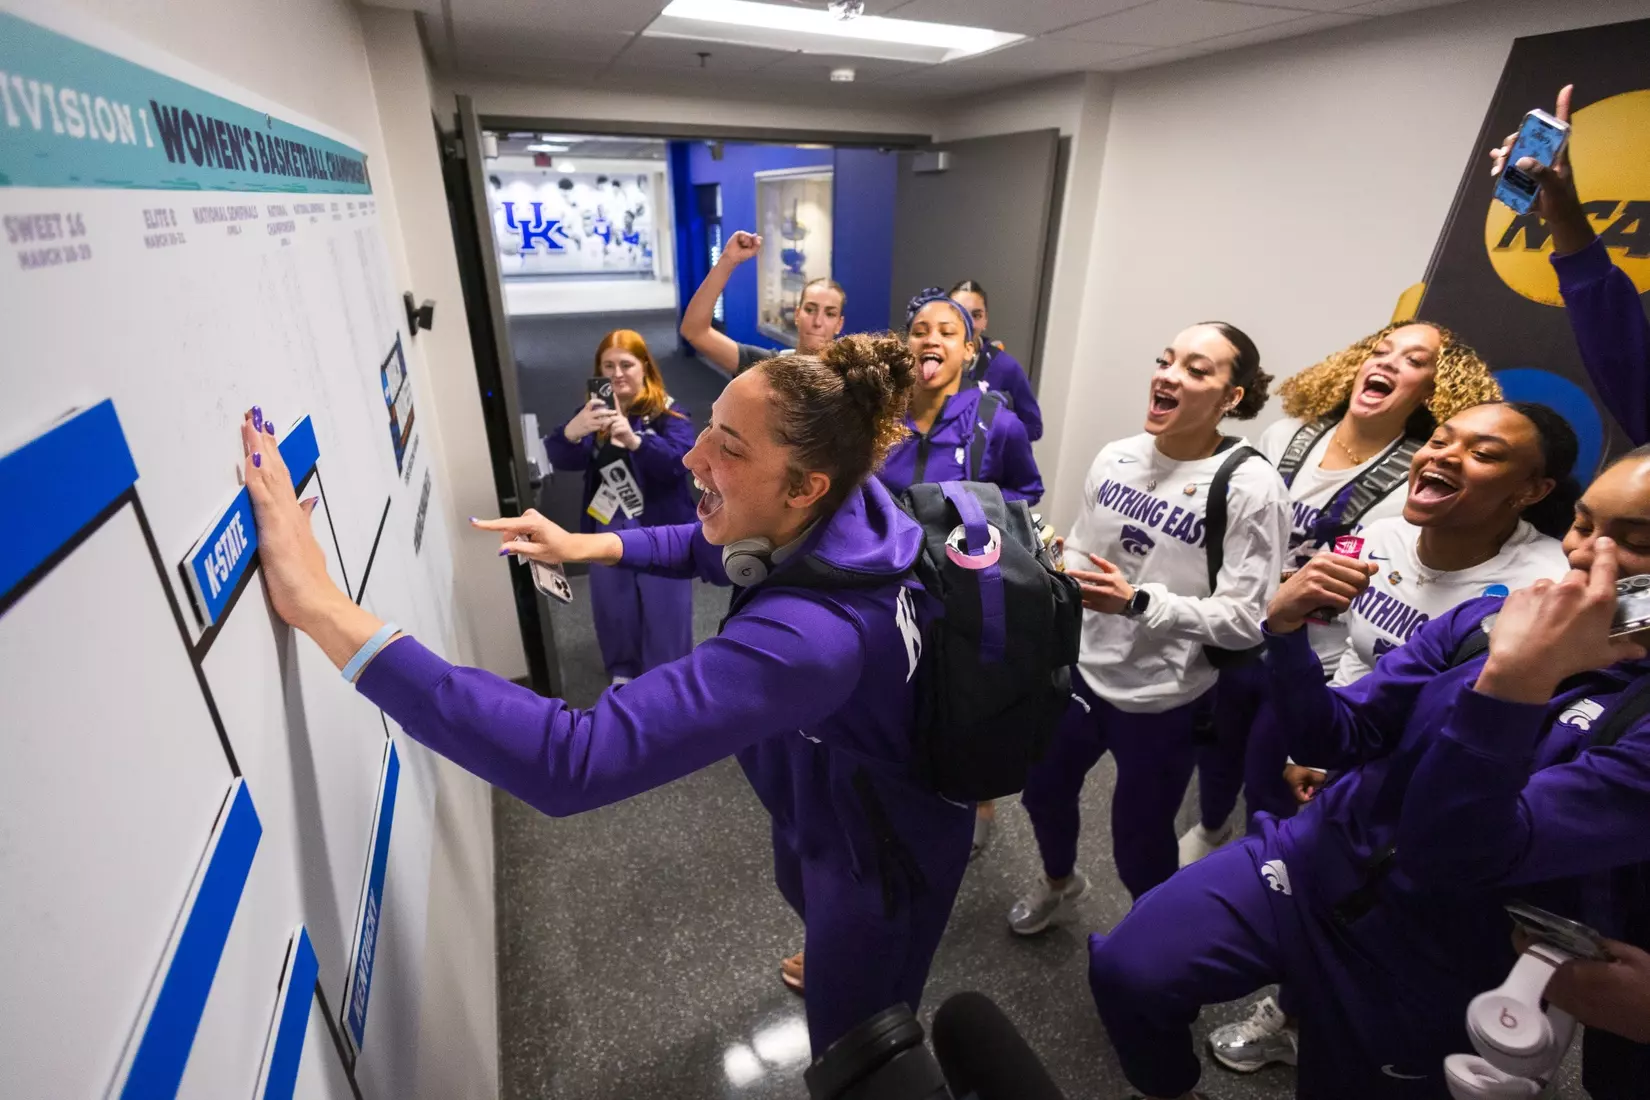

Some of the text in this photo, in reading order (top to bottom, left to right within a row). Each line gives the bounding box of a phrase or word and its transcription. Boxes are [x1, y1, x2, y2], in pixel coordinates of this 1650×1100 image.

[149, 97, 258, 172] WOMEN'S
[255, 130, 328, 180] BASKETBALL
[3, 212, 86, 244] SWEET 16
[142, 208, 171, 229] ELITE
[192, 206, 227, 225] NATIONAL
[501, 201, 565, 251] UK
[143, 233, 168, 249] MARCH
[18, 247, 63, 271] MARCH
[616, 481, 642, 511] TEAM
[1096, 479, 1207, 549] NOTHING EAS
[204, 510, 248, 599] K-STATE
[353, 887, 377, 1029] KENTUCKY
